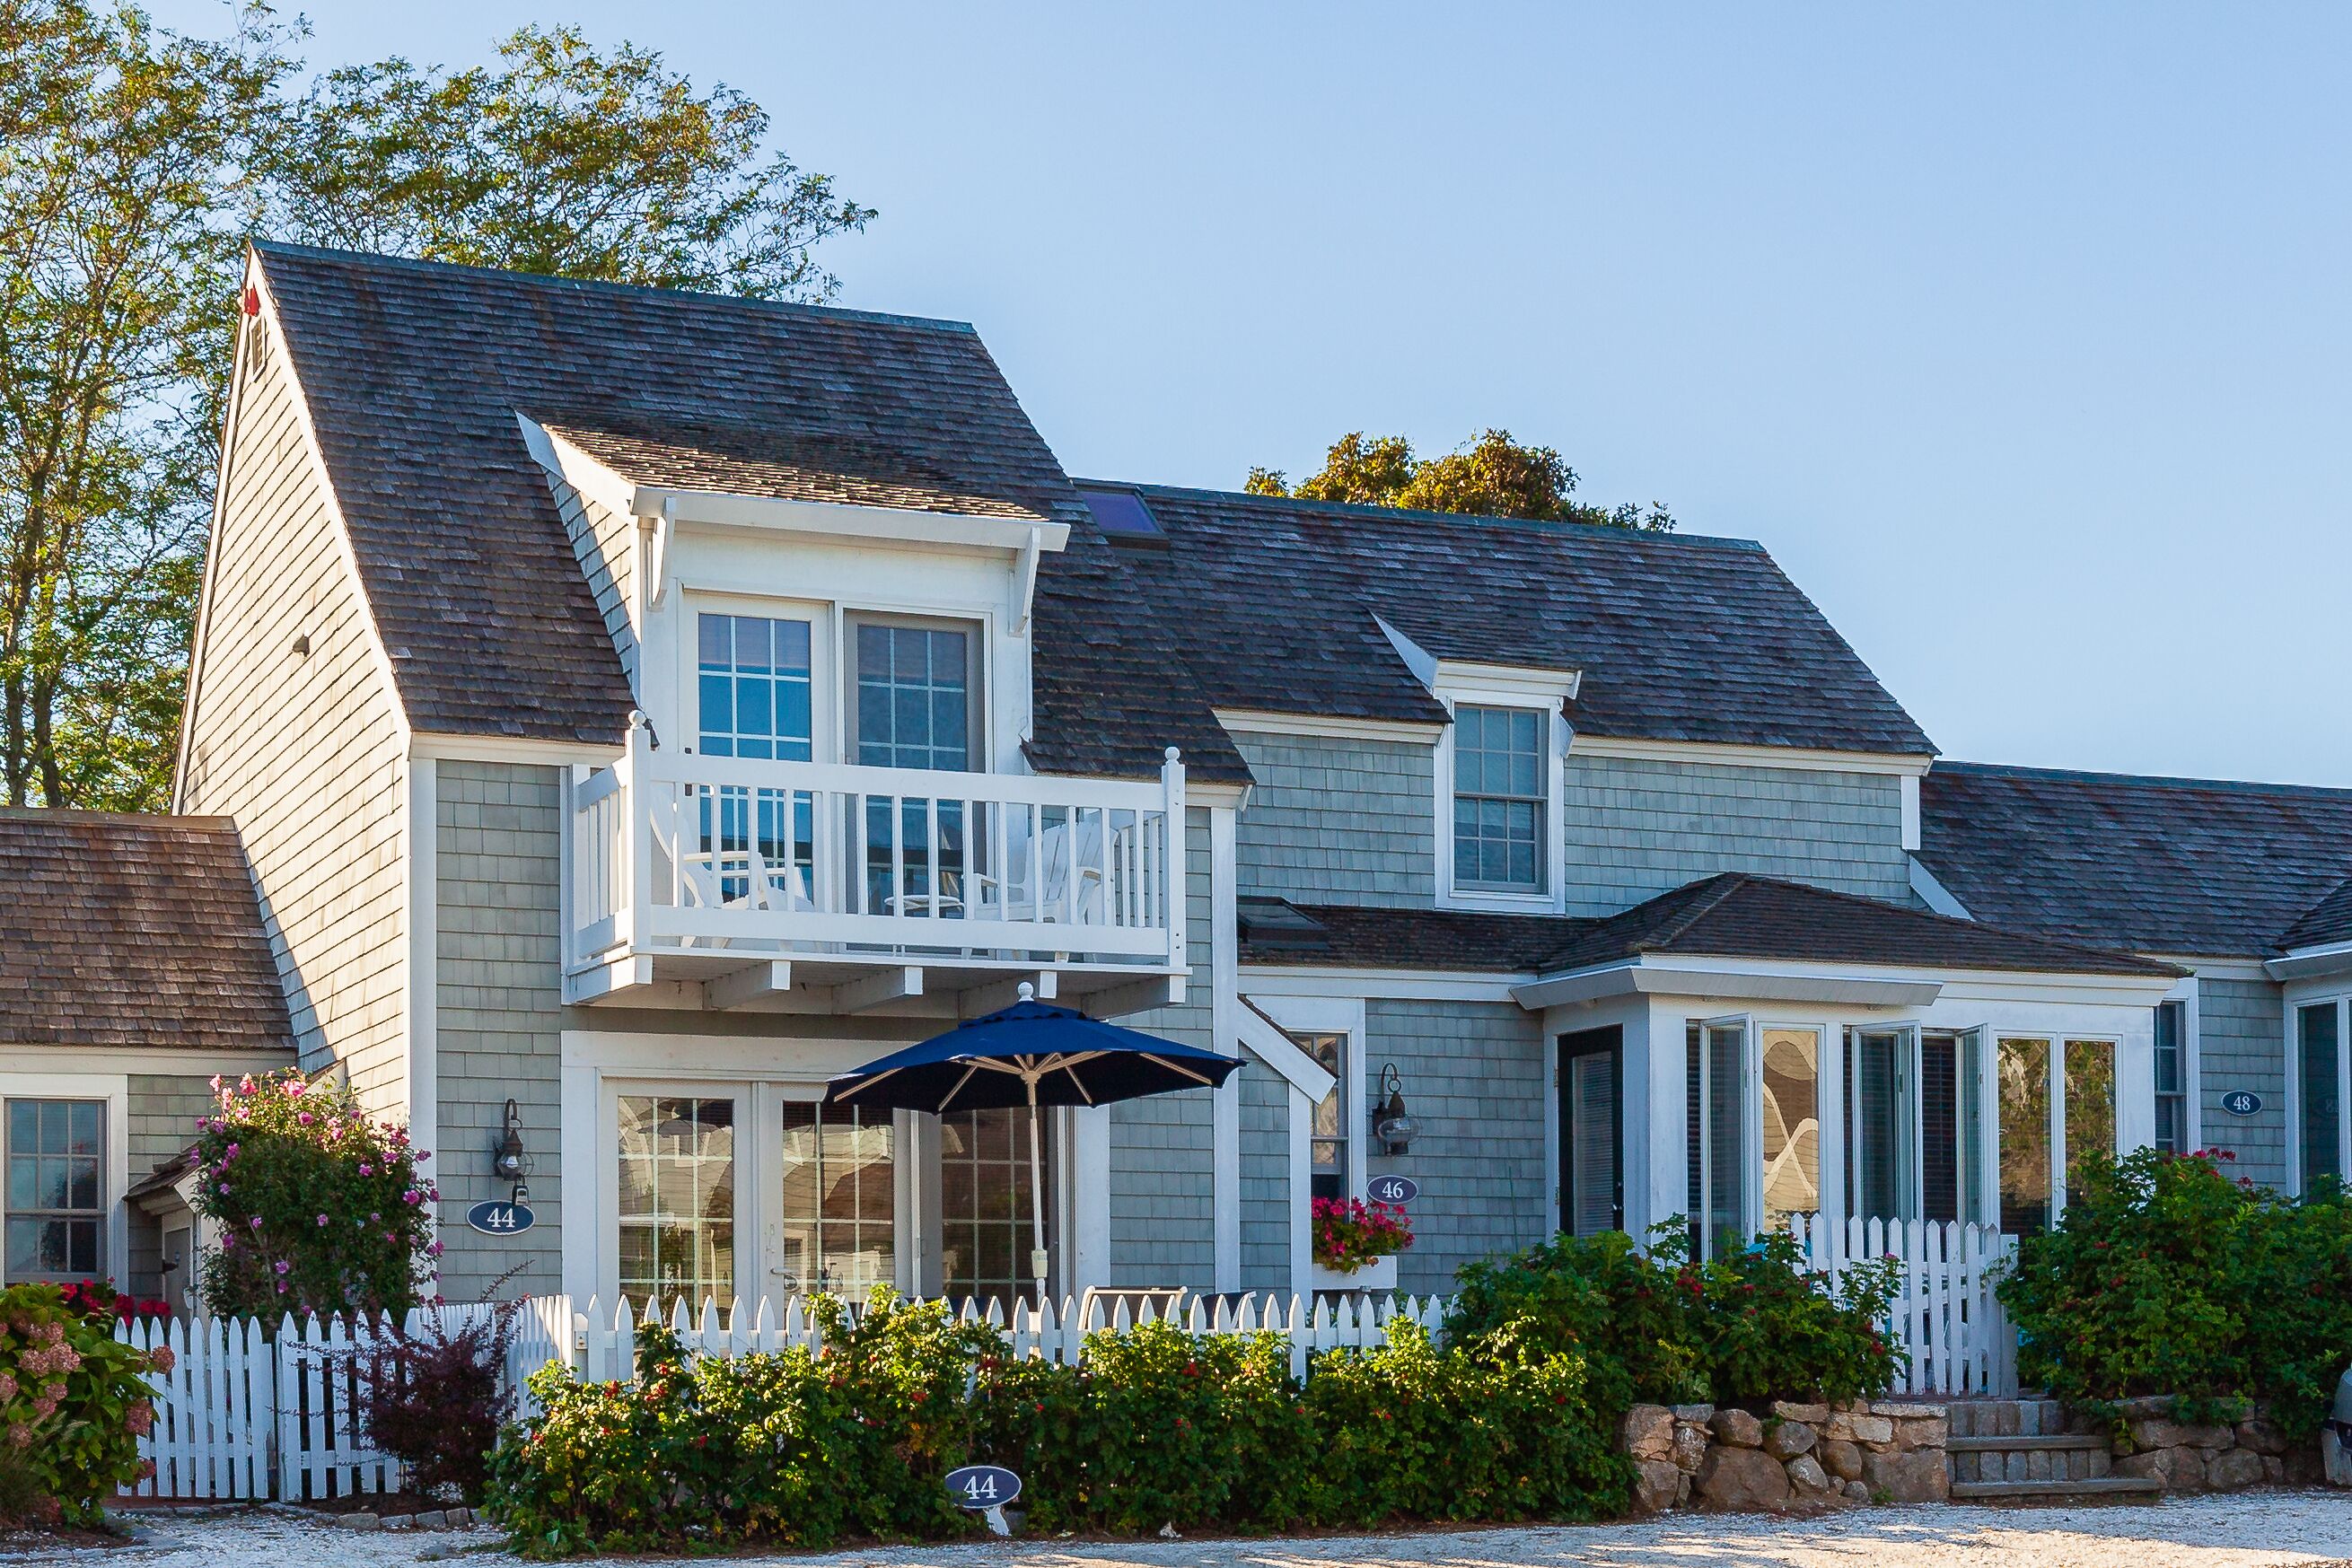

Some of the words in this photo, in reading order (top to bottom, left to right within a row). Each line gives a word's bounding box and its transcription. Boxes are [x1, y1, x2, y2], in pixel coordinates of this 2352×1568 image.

[2234, 1096, 2251, 1110] 48
[1382, 1181, 1403, 1198] 46
[487, 1207, 515, 1227] 44
[963, 1475, 997, 1499] 44
